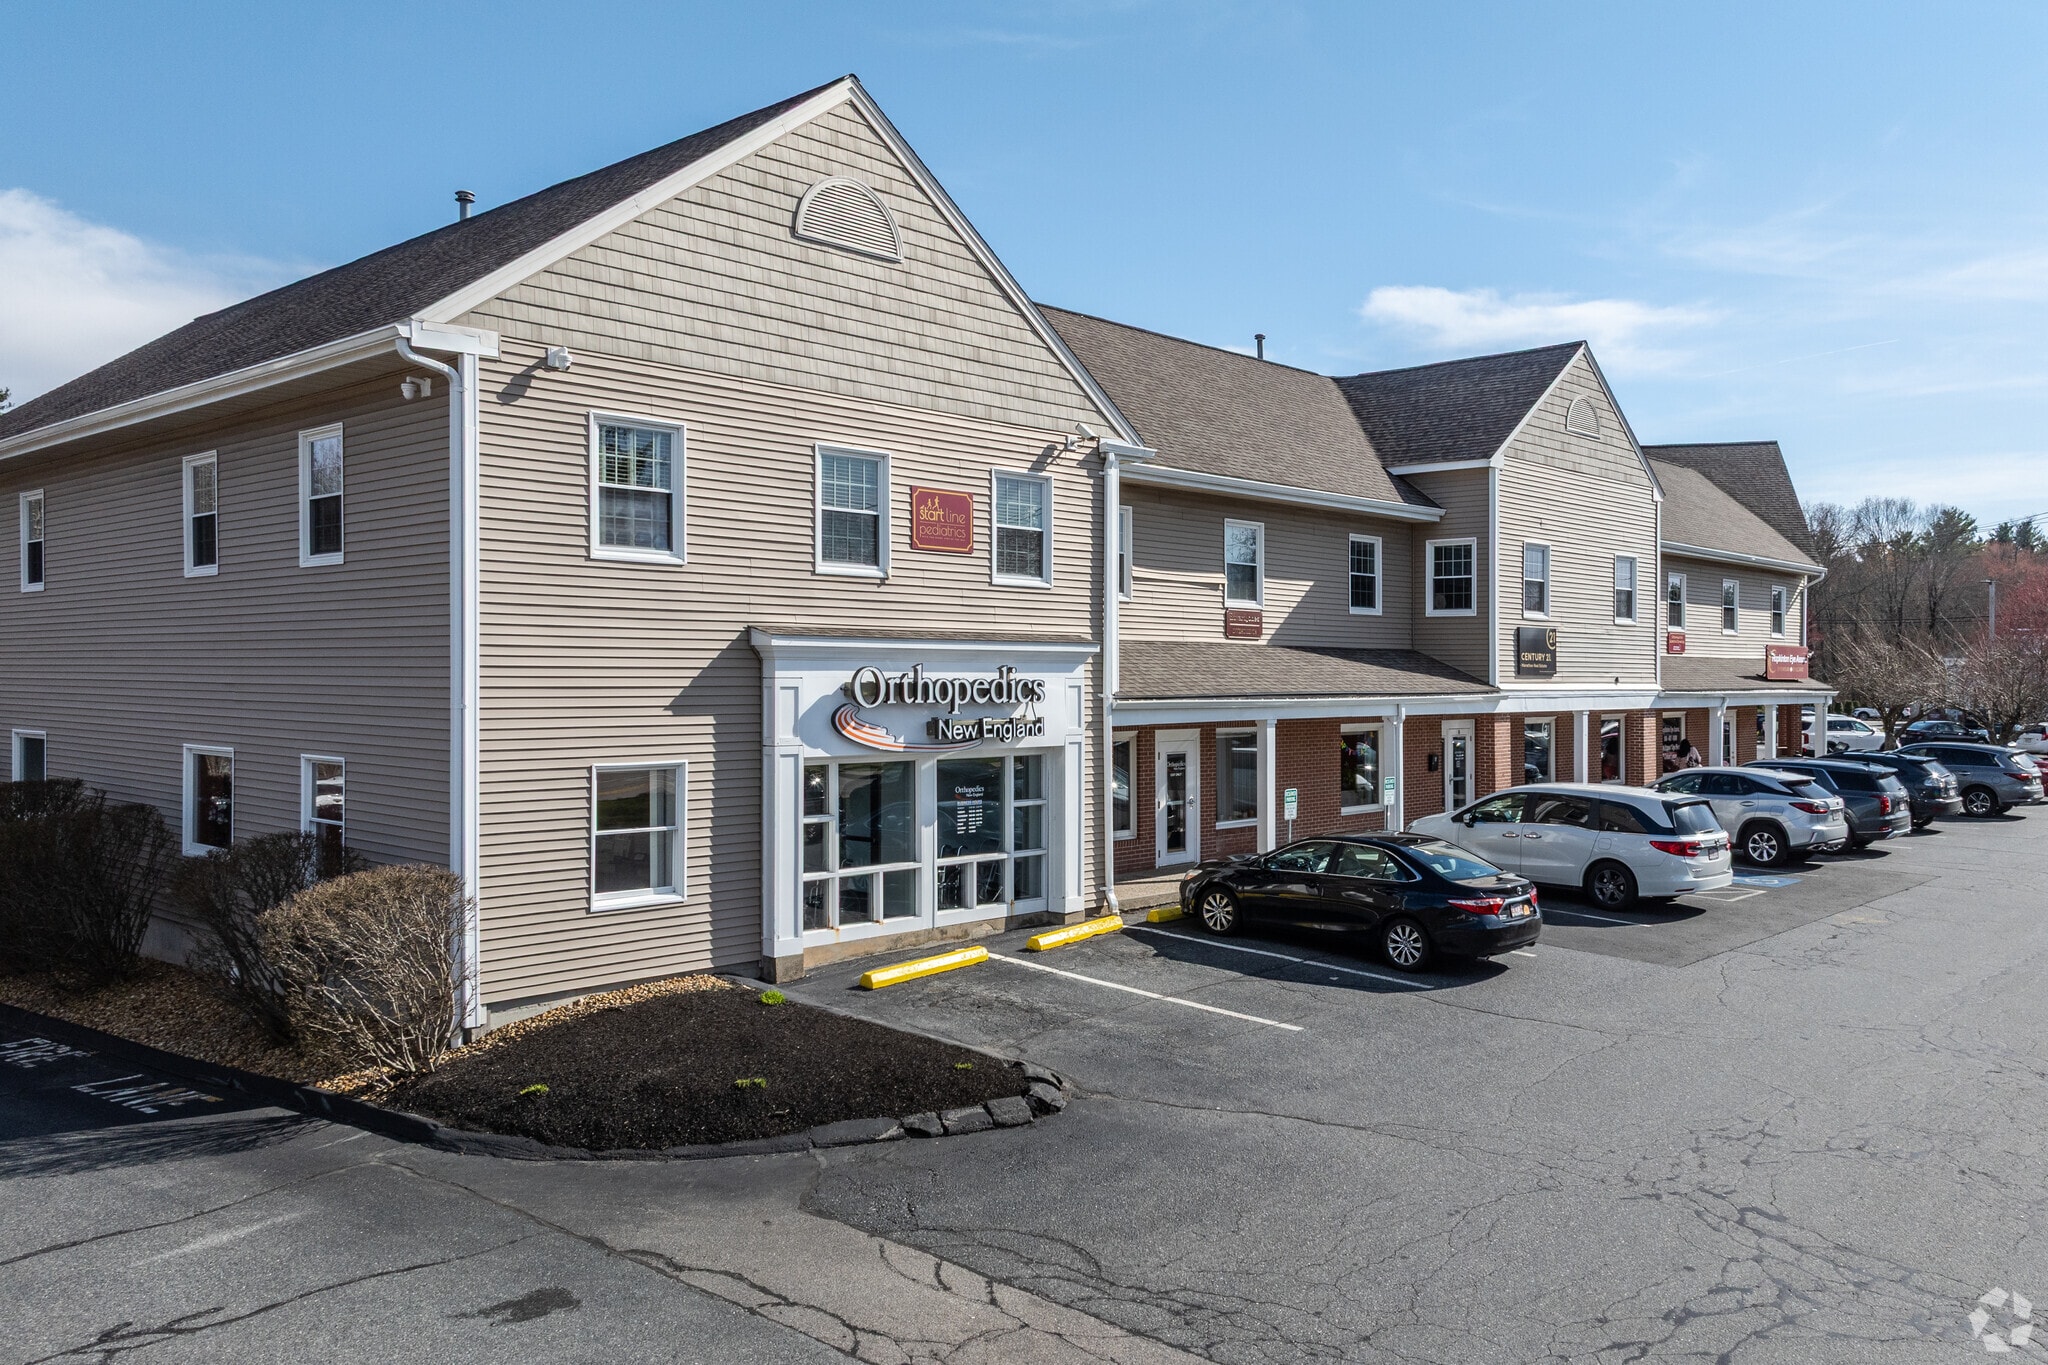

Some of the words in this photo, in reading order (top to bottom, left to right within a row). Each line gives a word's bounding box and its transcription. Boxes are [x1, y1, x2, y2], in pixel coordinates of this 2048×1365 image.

[919, 506, 945, 522] start
[945, 507, 966, 524] line
[919, 522, 967, 538] pediatrics
[1521, 652, 1545, 661] CENTURY
[851, 663, 1046, 715] Orthopedics
[938, 718, 979, 741] New
[982, 717, 1045, 743] England
